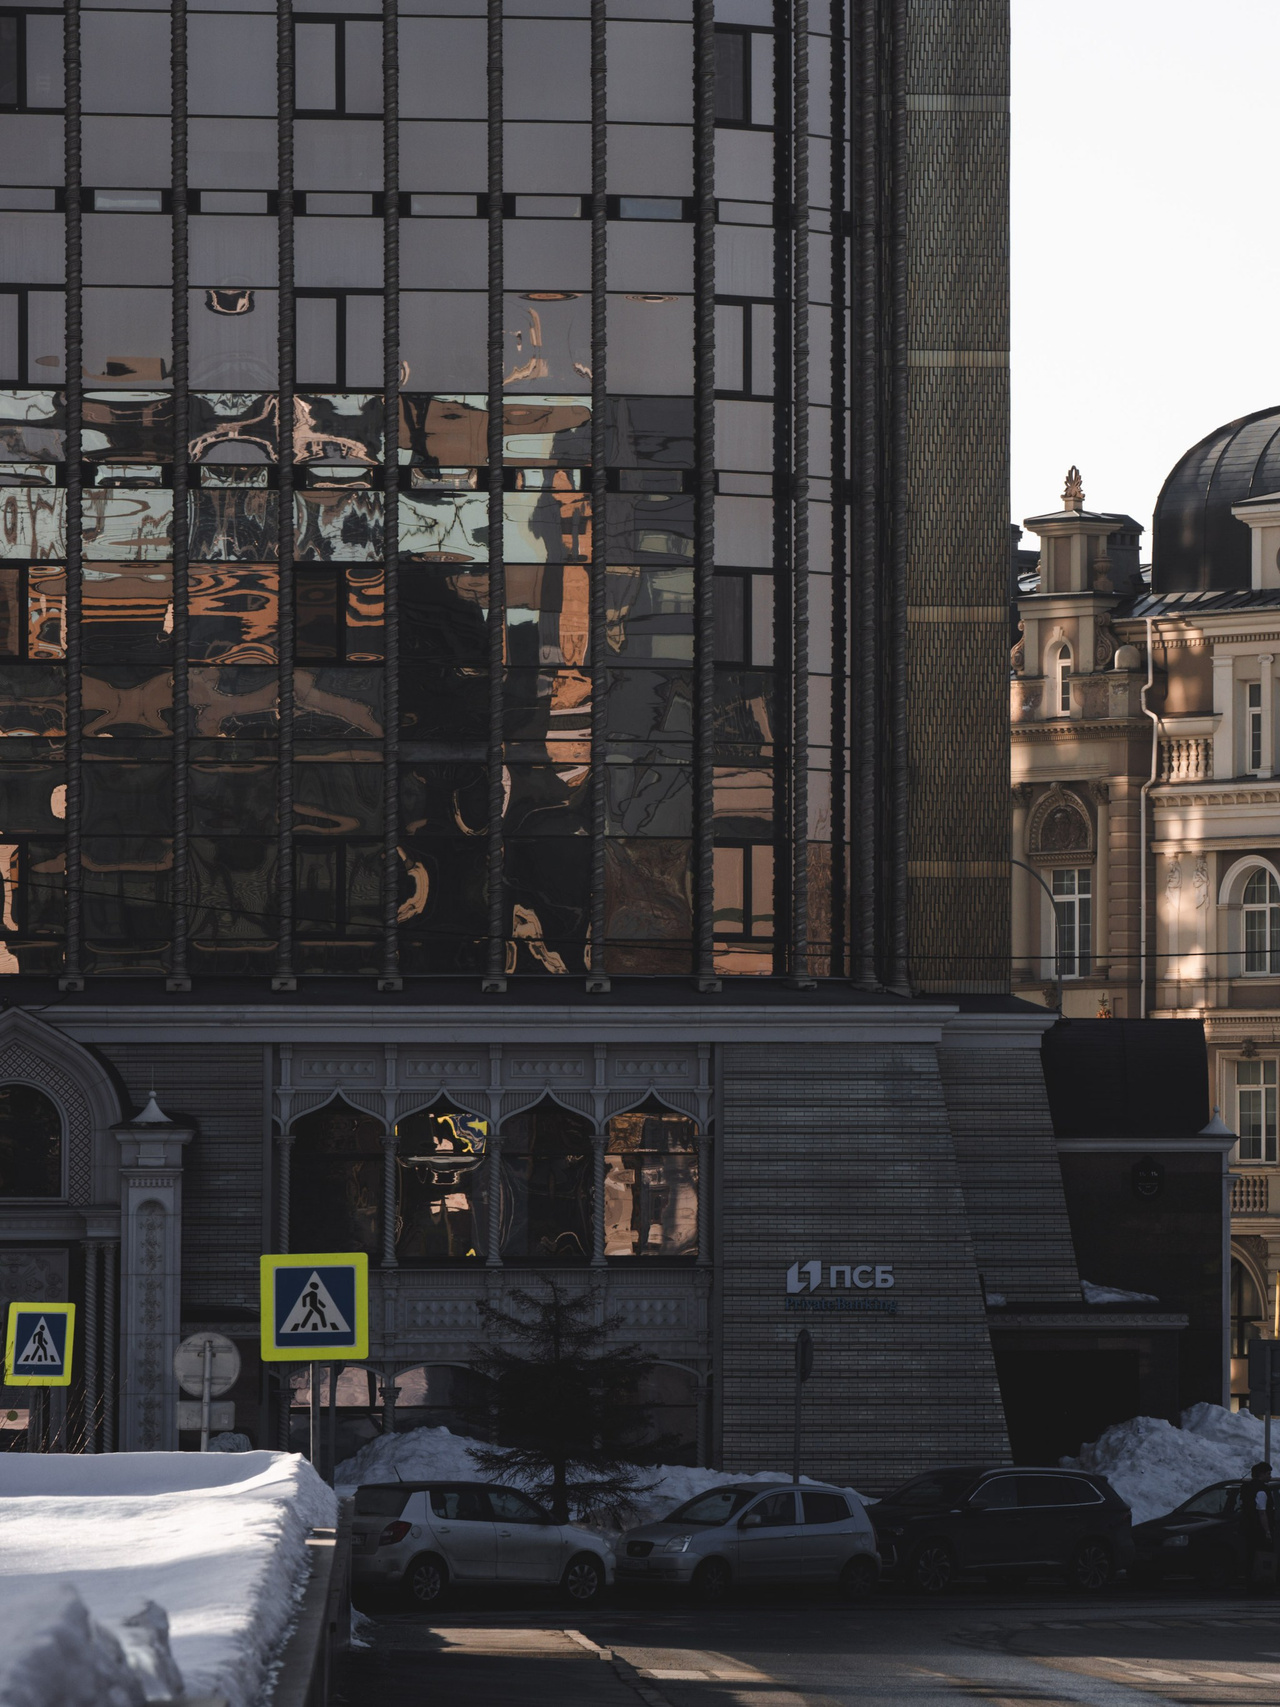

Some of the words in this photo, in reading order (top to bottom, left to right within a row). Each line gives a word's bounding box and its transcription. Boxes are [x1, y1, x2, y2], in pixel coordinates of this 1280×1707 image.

[829, 1265, 895, 1289] ПСБ
[784, 1297, 834, 1311] Private
[835, 1297, 898, 1315] Banking
